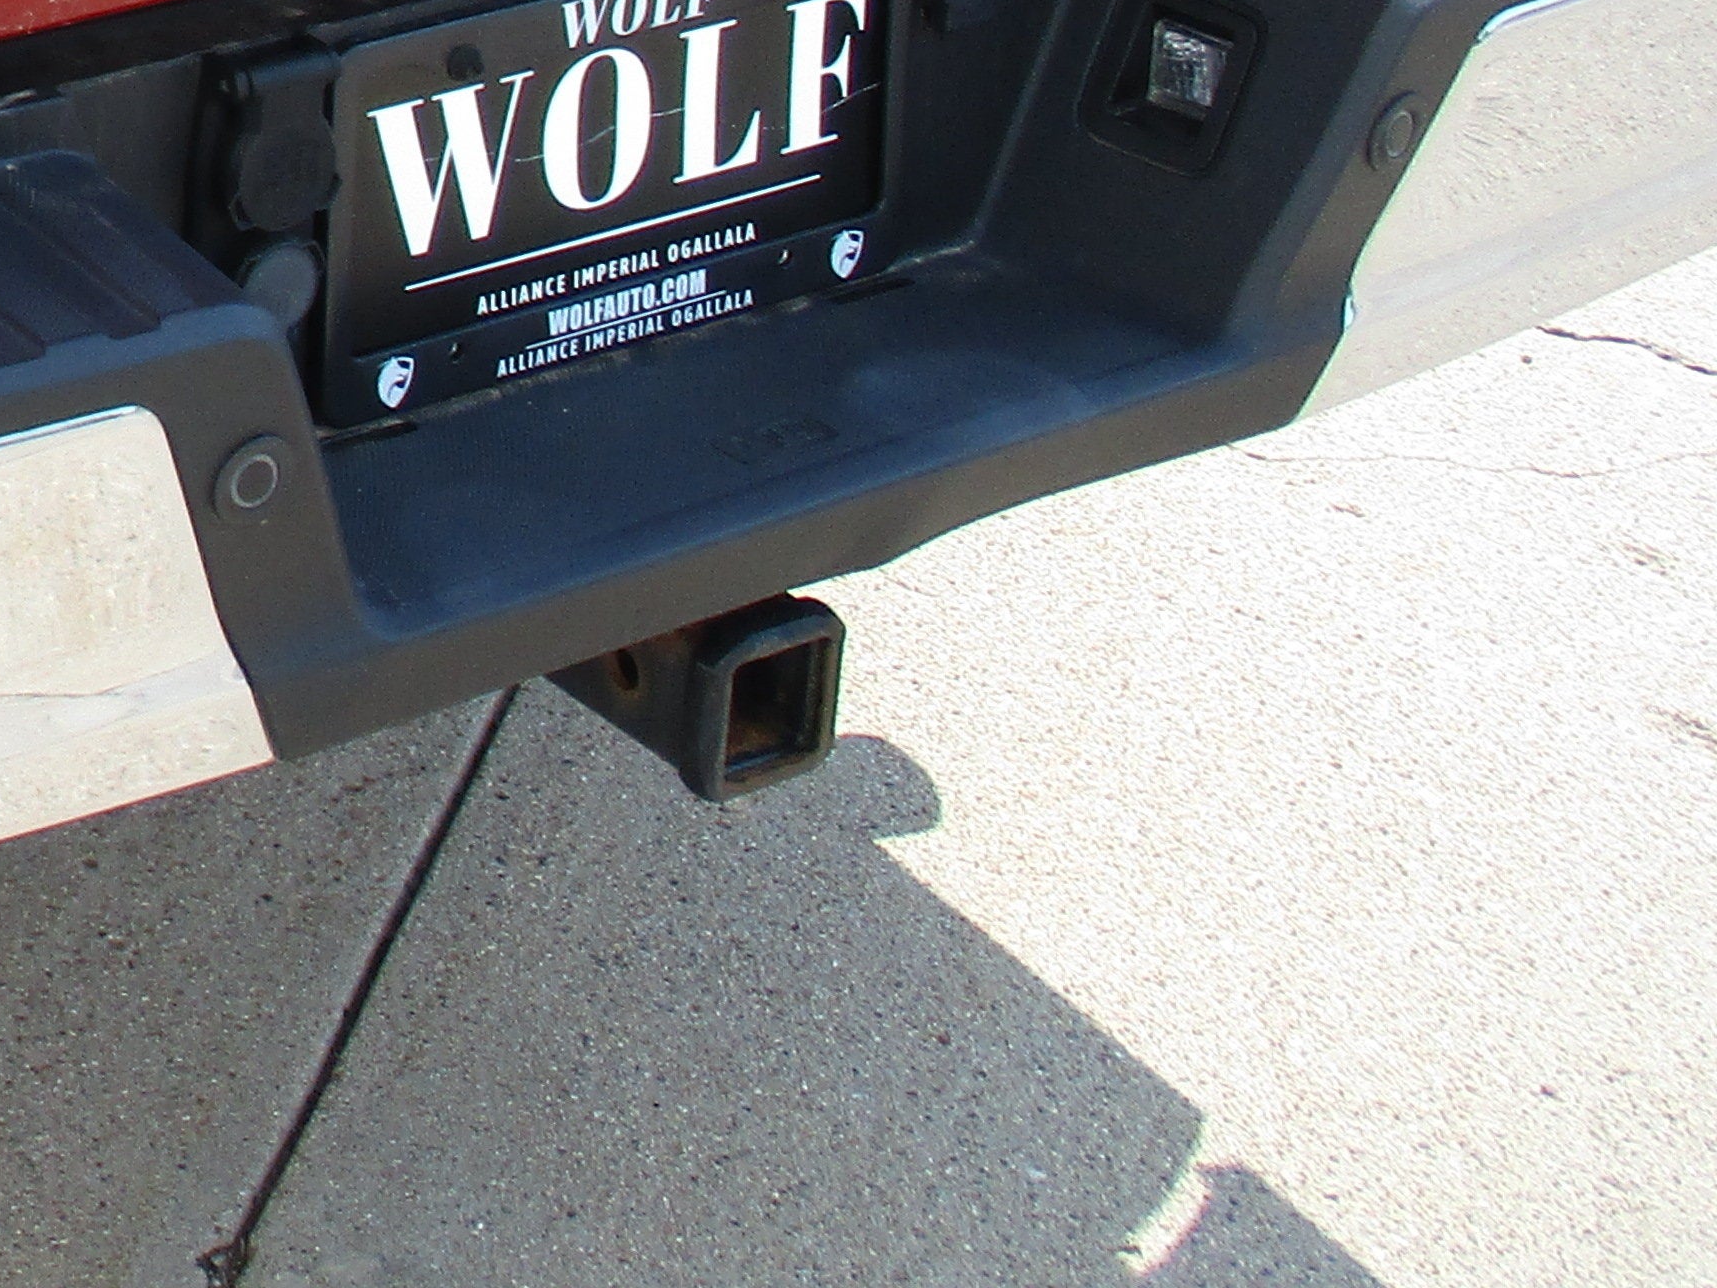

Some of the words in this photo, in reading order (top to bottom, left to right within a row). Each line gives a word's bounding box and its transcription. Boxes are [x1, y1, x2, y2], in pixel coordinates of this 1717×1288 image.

[476, 273, 566, 315] ALLIANCE
[573, 249, 660, 289] IMPERIAL
[667, 222, 757, 263] OGALLALA
[547, 268, 708, 336] WOLFAUTO.COM
[496, 339, 579, 378] ALLIANCE
[584, 320, 665, 353] IMPERIAL
[671, 289, 755, 327] OGALLALA
